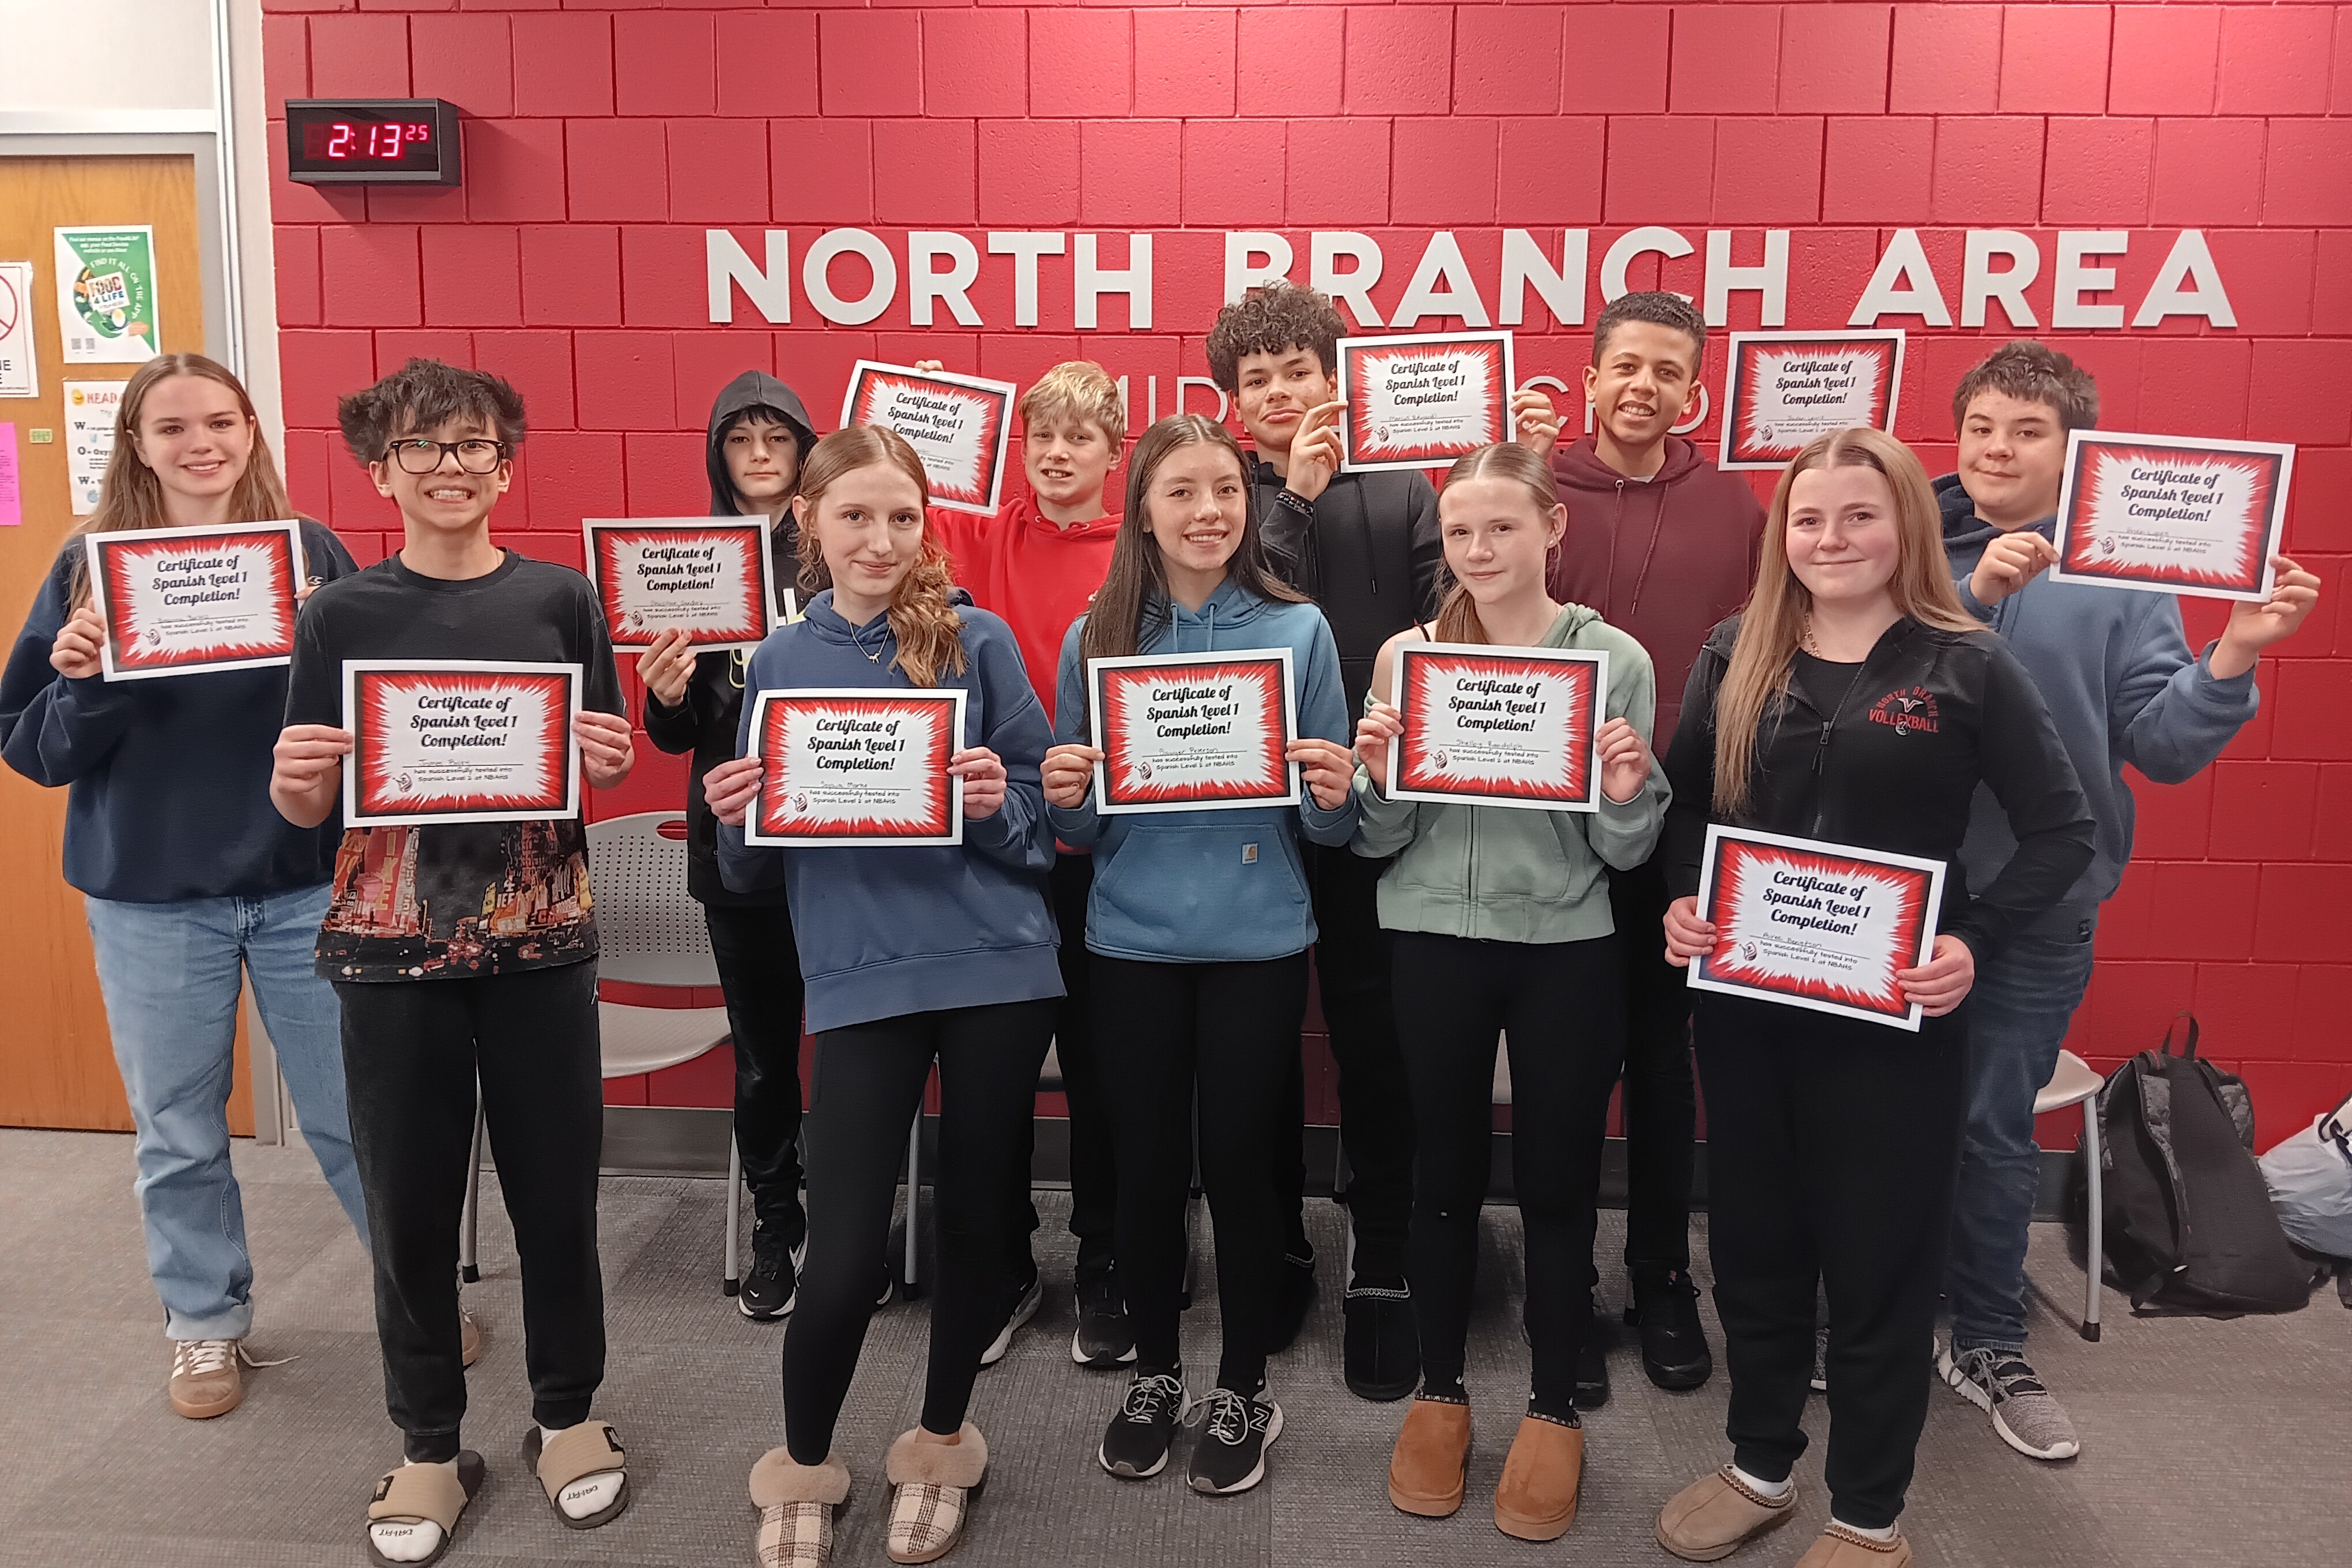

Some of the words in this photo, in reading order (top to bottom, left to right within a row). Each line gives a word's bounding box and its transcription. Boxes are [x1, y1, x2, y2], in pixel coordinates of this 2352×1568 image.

[329, 125, 401, 157] 2:13
[405, 125, 427, 141] 25
[118, 261, 130, 273] ALL
[706, 228, 1152, 329] NORTH
[1224, 226, 1790, 327] BRANCH
[1848, 229, 2237, 329] AREA
[89, 276, 122, 297] FOOD
[101, 291, 125, 303] LIFE
[1391, 363, 1446, 375] Certificate
[1449, 360, 1460, 373] of
[1784, 361, 1838, 375] Certificate
[1841, 361, 1853, 374] of
[1386, 378, 1429, 392] Spanish
[1433, 376, 1458, 389] Level
[1461, 375, 1465, 385] 1
[1776, 378, 1820, 391] Spanish
[1823, 377, 1848, 391] Level
[1850, 376, 1856, 387] 1
[896, 393, 947, 411] Certificate
[949, 404, 961, 416] of
[1394, 391, 1458, 406] Completion!
[1783, 393, 1848, 407] Completion!
[888, 407, 930, 424] Spanish
[932, 414, 956, 429] Level
[958, 419, 964, 429] 1
[894, 423, 955, 443] Completion!
[2131, 468, 2201, 485] Certificate
[2204, 474, 2220, 489] of
[2121, 485, 2176, 501] Spanish
[2180, 489, 2213, 505] Level
[2216, 493, 2223, 504] 1
[2128, 503, 2211, 521] Completion!
[642, 548, 700, 561] Certificate
[703, 546, 715, 560] of
[157, 558, 223, 573] Certificate
[227, 556, 240, 569] of
[638, 564, 684, 577] Spanish
[687, 563, 714, 576] Level
[716, 562, 721, 573] 1
[152, 575, 205, 592] Spanish
[209, 571, 239, 588] Level
[242, 571, 247, 582] 1
[647, 578, 714, 593] Completion!
[164, 589, 240, 606] Completion!
[1153, 687, 1216, 703] Certificate
[1219, 685, 1232, 700] of
[1457, 679, 1523, 695] Certificate
[1527, 683, 1541, 698] of
[418, 696, 493, 713] Certificate
[496, 697, 512, 713] of
[1449, 696, 1501, 713] Spanish
[1506, 700, 1537, 715] Level
[1539, 702, 1546, 714] 1
[1876, 688, 1906, 708] NORTH
[1147, 707, 1197, 722] Spanish
[1201, 704, 1230, 719] Level
[1234, 703, 1238, 715] 1
[1869, 709, 1939, 733] VOLLEYBALL
[410, 715, 469, 732] Spanish
[474, 715, 508, 731] Level
[511, 715, 518, 728] 1
[816, 719, 883, 735] Certificate
[886, 721, 900, 736] of
[1157, 722, 1231, 739] Completion!
[1457, 715, 1536, 732] Completion!
[421, 734, 507, 750] Completion!
[808, 737, 861, 753] Spanish
[865, 738, 895, 754] Level
[899, 739, 905, 752] 1
[817, 756, 895, 772] Completion!
[1773, 871, 1848, 895] Certificate
[1850, 885, 1867, 901] of
[1763, 888, 1821, 910] Spanish
[1826, 899, 1861, 917] Level
[1863, 906, 1871, 918] 1
[1771, 909, 1858, 936] Completion!
